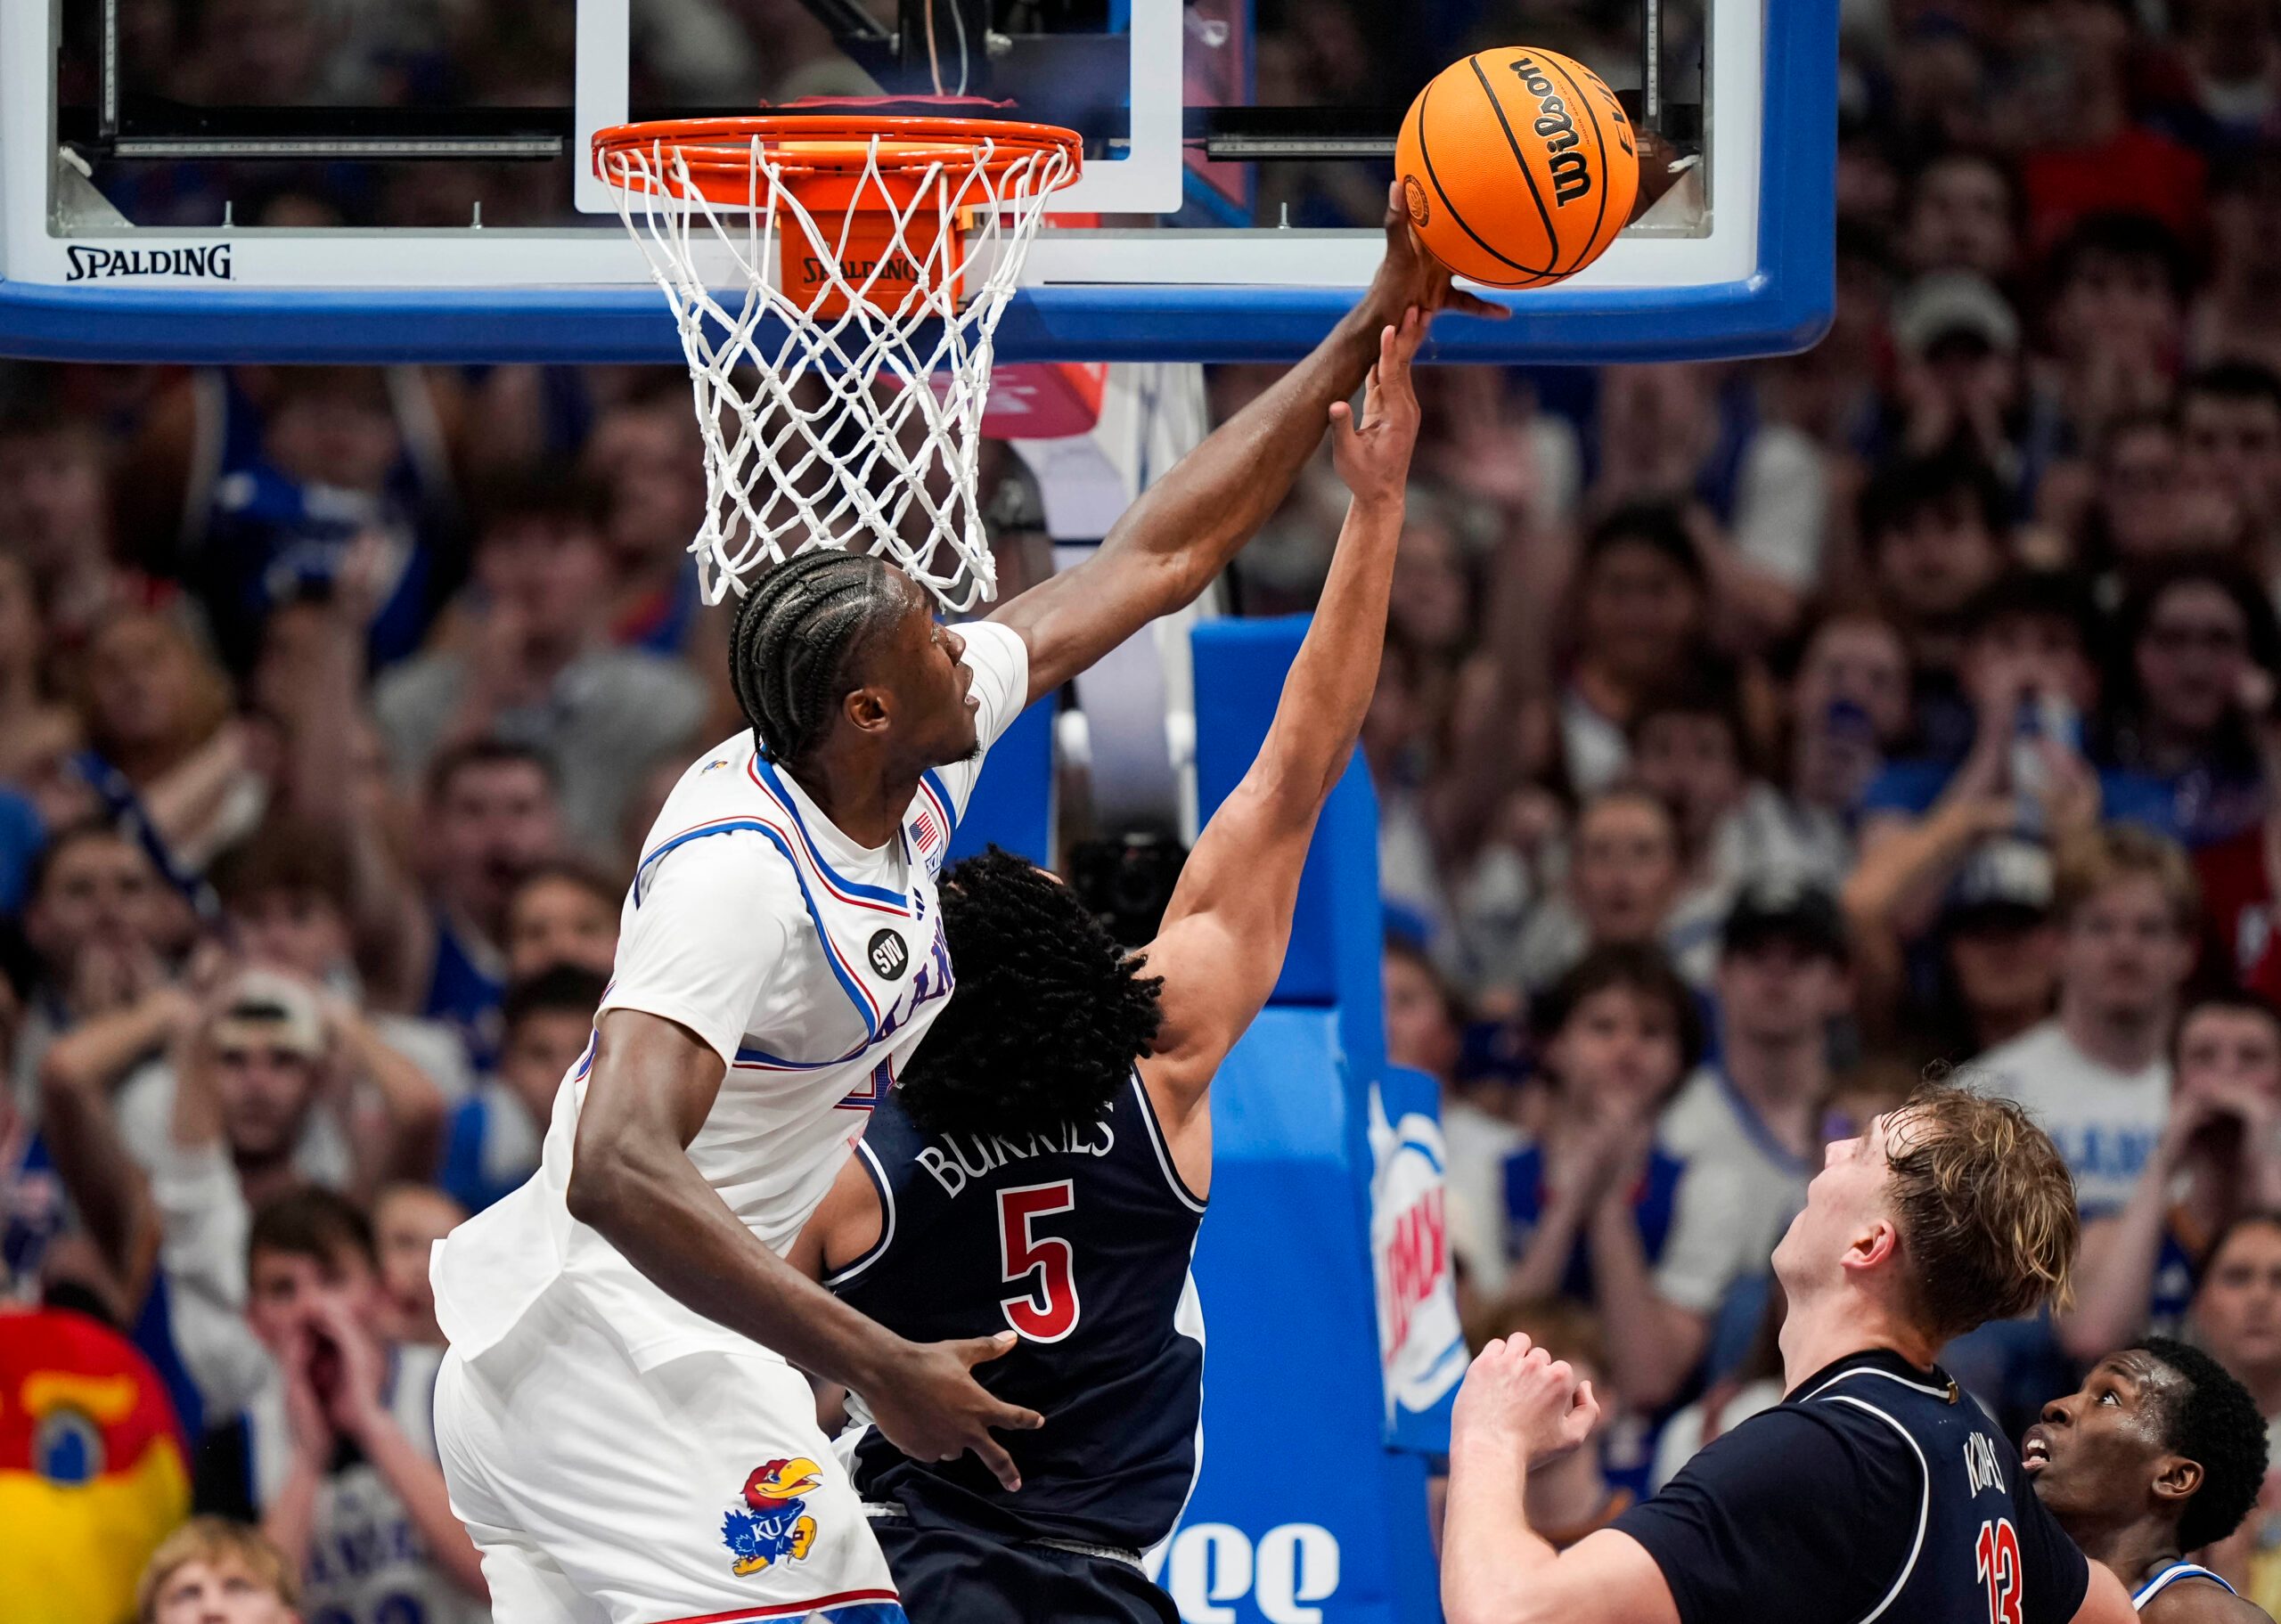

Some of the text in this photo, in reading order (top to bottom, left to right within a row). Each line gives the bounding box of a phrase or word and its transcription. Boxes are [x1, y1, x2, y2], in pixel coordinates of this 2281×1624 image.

[1508, 57, 1591, 208] Wilson
[67, 243, 231, 282] SPALDING
[872, 934, 905, 975] SW
[995, 1178, 1081, 1344] 5
[750, 1516, 782, 1542] KU
[1142, 1522, 1340, 1624] ee
[1974, 1517, 2023, 1624] 13
